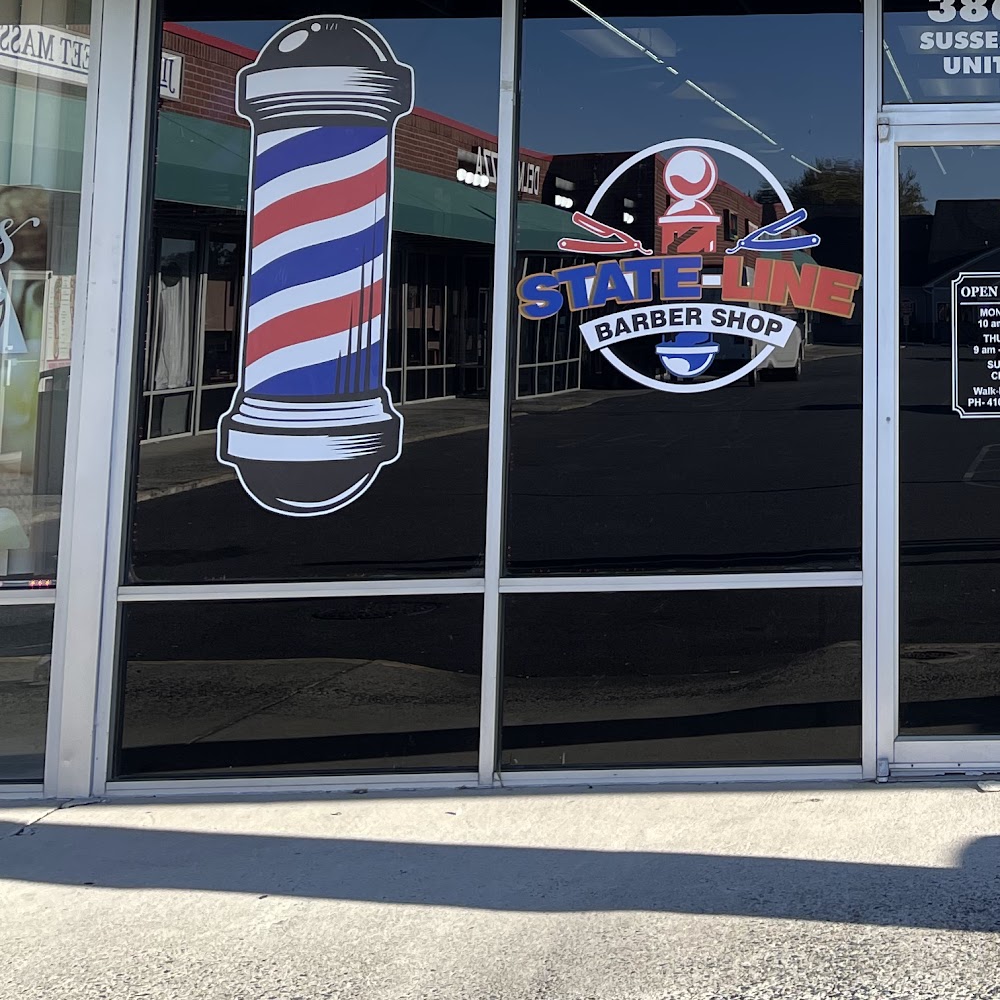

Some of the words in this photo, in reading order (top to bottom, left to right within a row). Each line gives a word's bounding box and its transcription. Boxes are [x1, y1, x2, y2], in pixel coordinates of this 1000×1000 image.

[961, 285, 998, 298] OPEN
[594, 307, 702, 342] BARBER
[710, 308, 783, 337] SHOP
[978, 320, 989, 328] 10
[973, 346, 979, 354] 9
